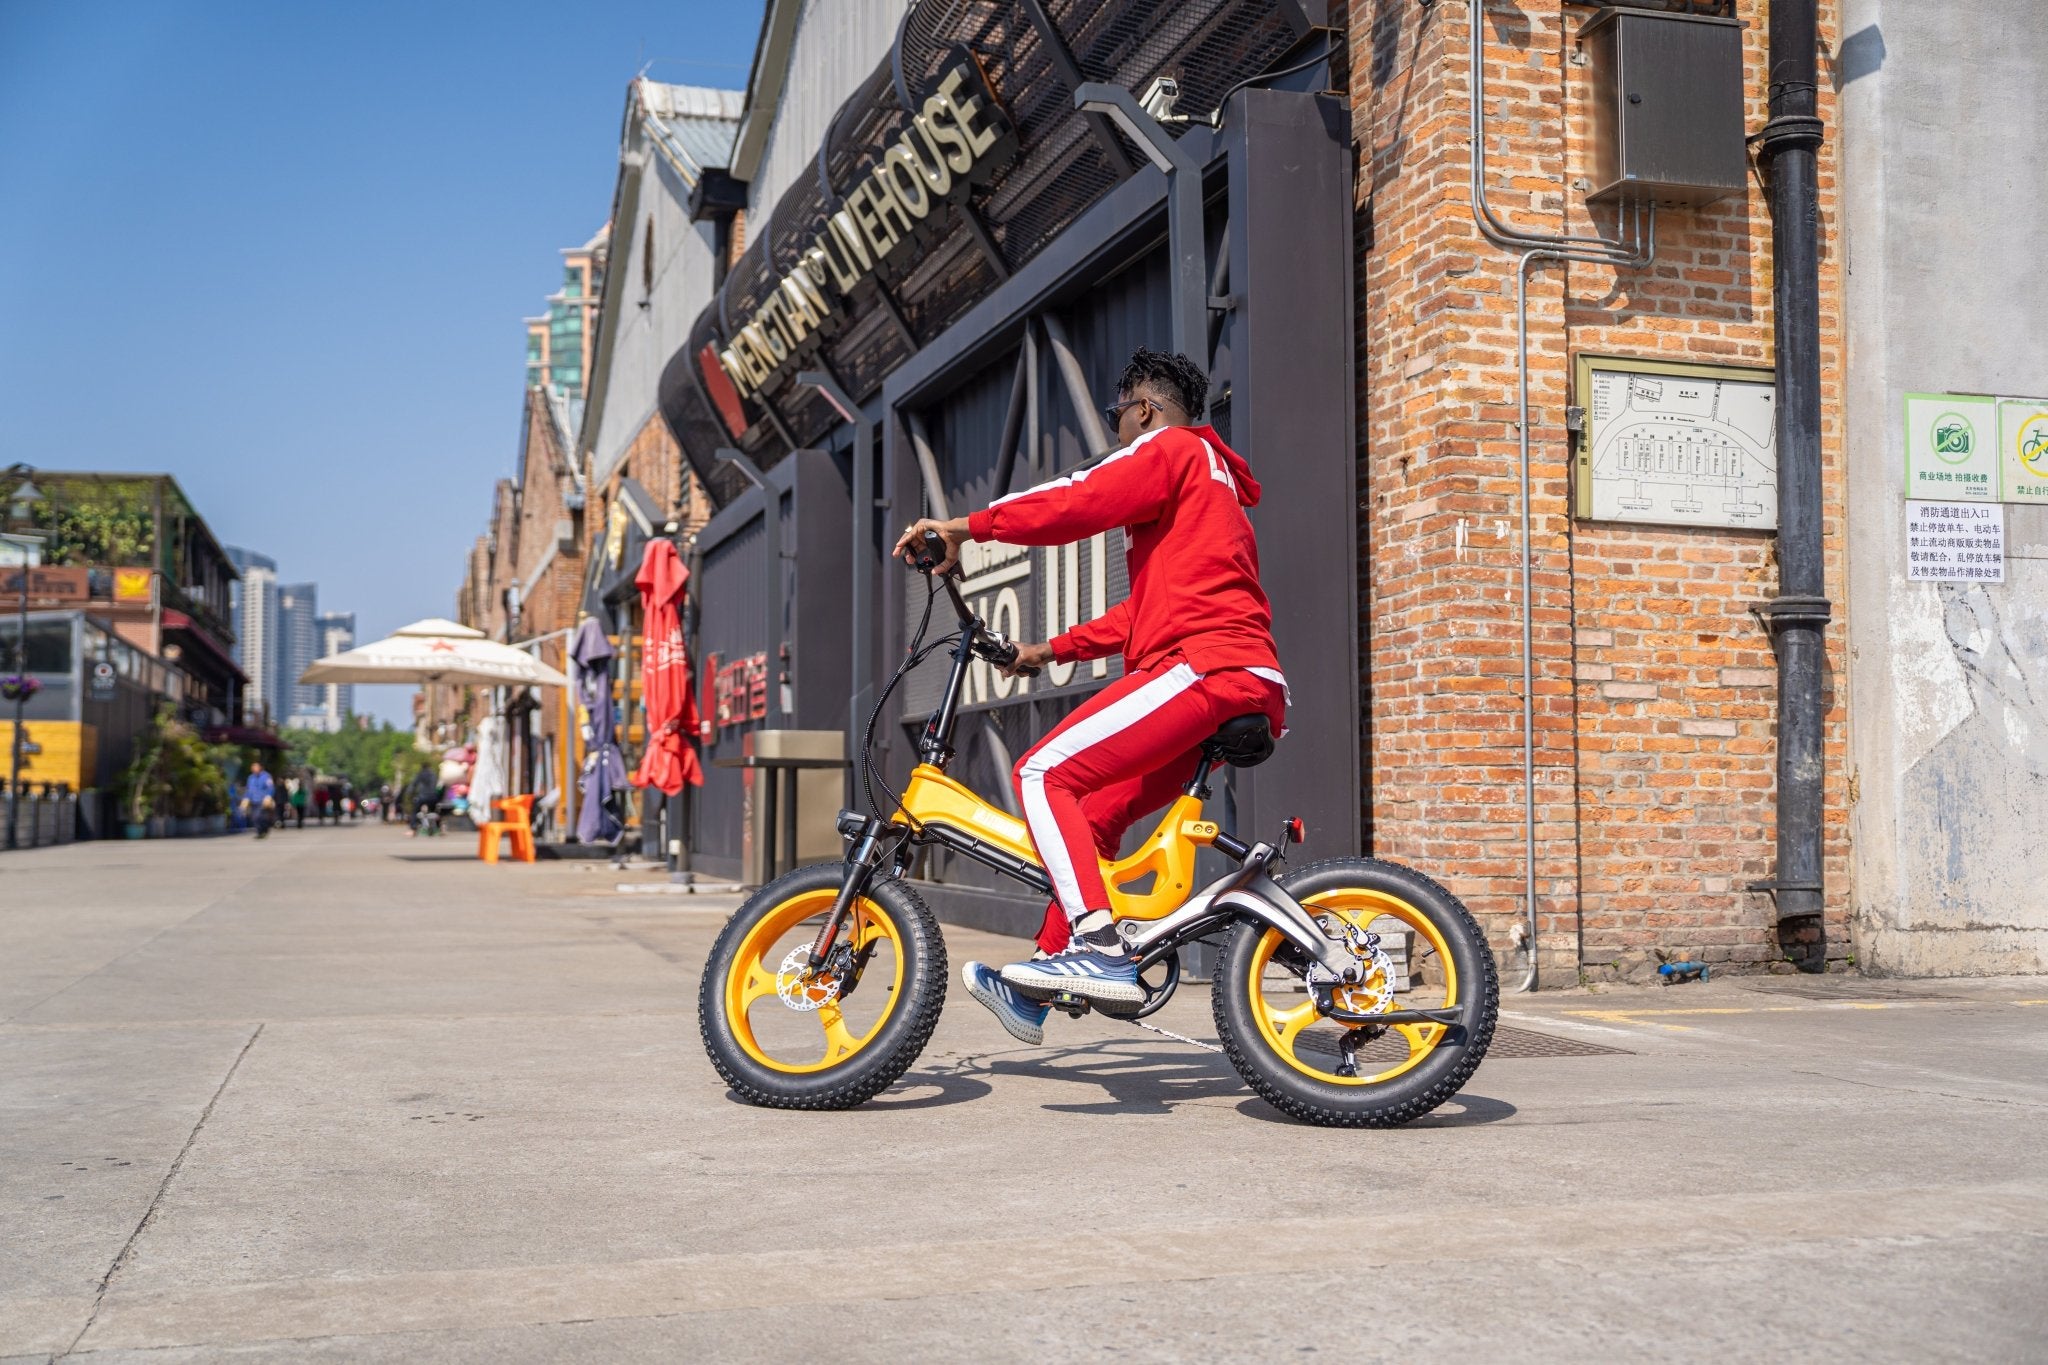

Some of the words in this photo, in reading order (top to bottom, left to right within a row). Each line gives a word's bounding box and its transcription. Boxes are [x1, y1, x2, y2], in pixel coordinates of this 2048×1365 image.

[815, 63, 999, 294] LIVEHOUSE
[1919, 471, 1952, 481] 商业场地
[1955, 473, 1988, 483] 拍摄收费
[1920, 506, 1989, 518] 消防通道出入口
